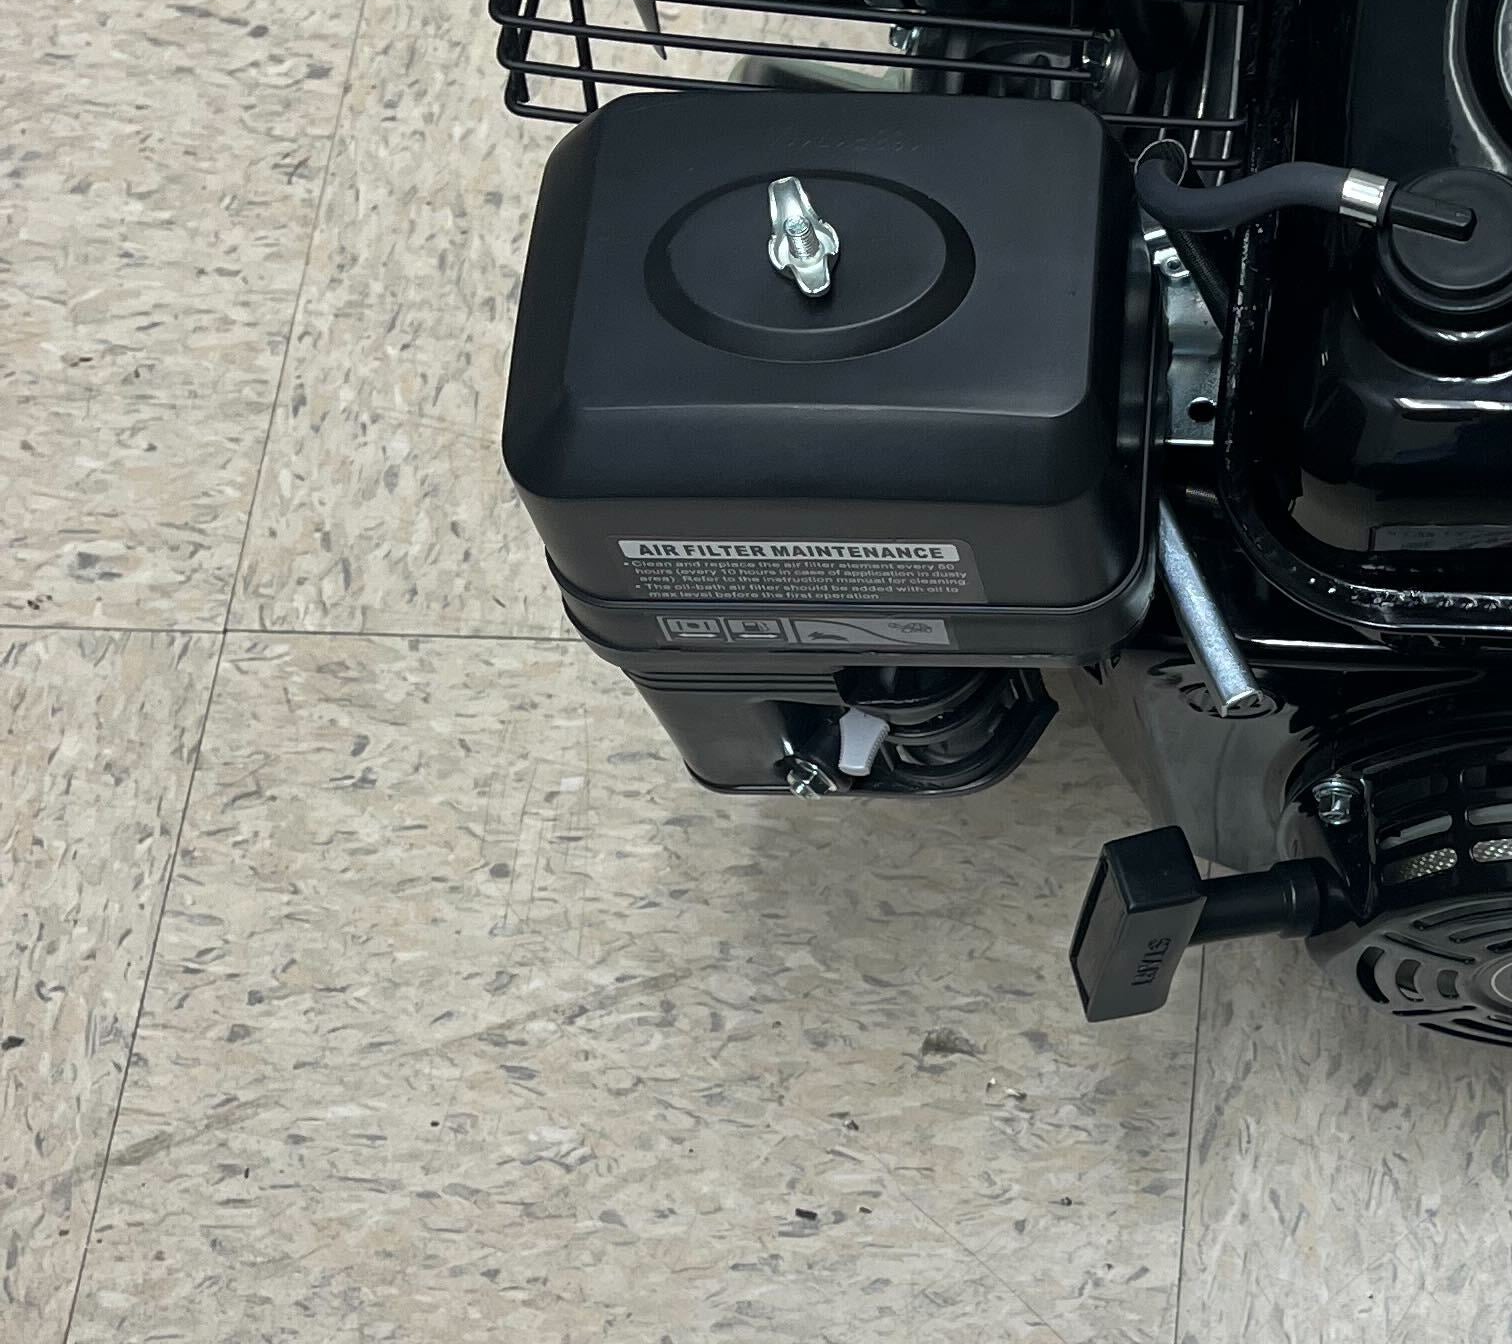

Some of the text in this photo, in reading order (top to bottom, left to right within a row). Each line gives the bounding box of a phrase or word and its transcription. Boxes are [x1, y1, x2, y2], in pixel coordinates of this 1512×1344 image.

[639, 544, 945, 559] AIR FILTER MAINTENANCE
[631, 560, 673, 568] Clean
[675, 560, 701, 568] and
[704, 561, 756, 569] replace
[757, 560, 781, 568] the
[783, 561, 801, 569] air
[803, 561, 835, 569] filter
[838, 562, 894, 570] element
[897, 563, 935, 571] every
[635, 568, 673, 576] hours
[675, 568, 717, 576] (every
[721, 568, 736, 576] 10
[739, 568, 777, 576] hours
[779, 568, 792, 576] in
[844, 569, 916, 578] application
[931, 571, 968, 579] dusty
[682, 575, 719, 583] Refer
[763, 576, 834, 584] instruction
[888, 577, 907, 585] for
[645, 583, 672, 591] The
[674, 583, 726, 591] oil-bath
[783, 584, 828, 592] should
[831, 584, 848, 592] be
[851, 585, 893, 593] added
[896, 585, 924, 593] with
[649, 591, 677, 599] max
[715, 591, 762, 599] before
[762, 591, 783, 599] the
[785, 591, 813, 599] first
